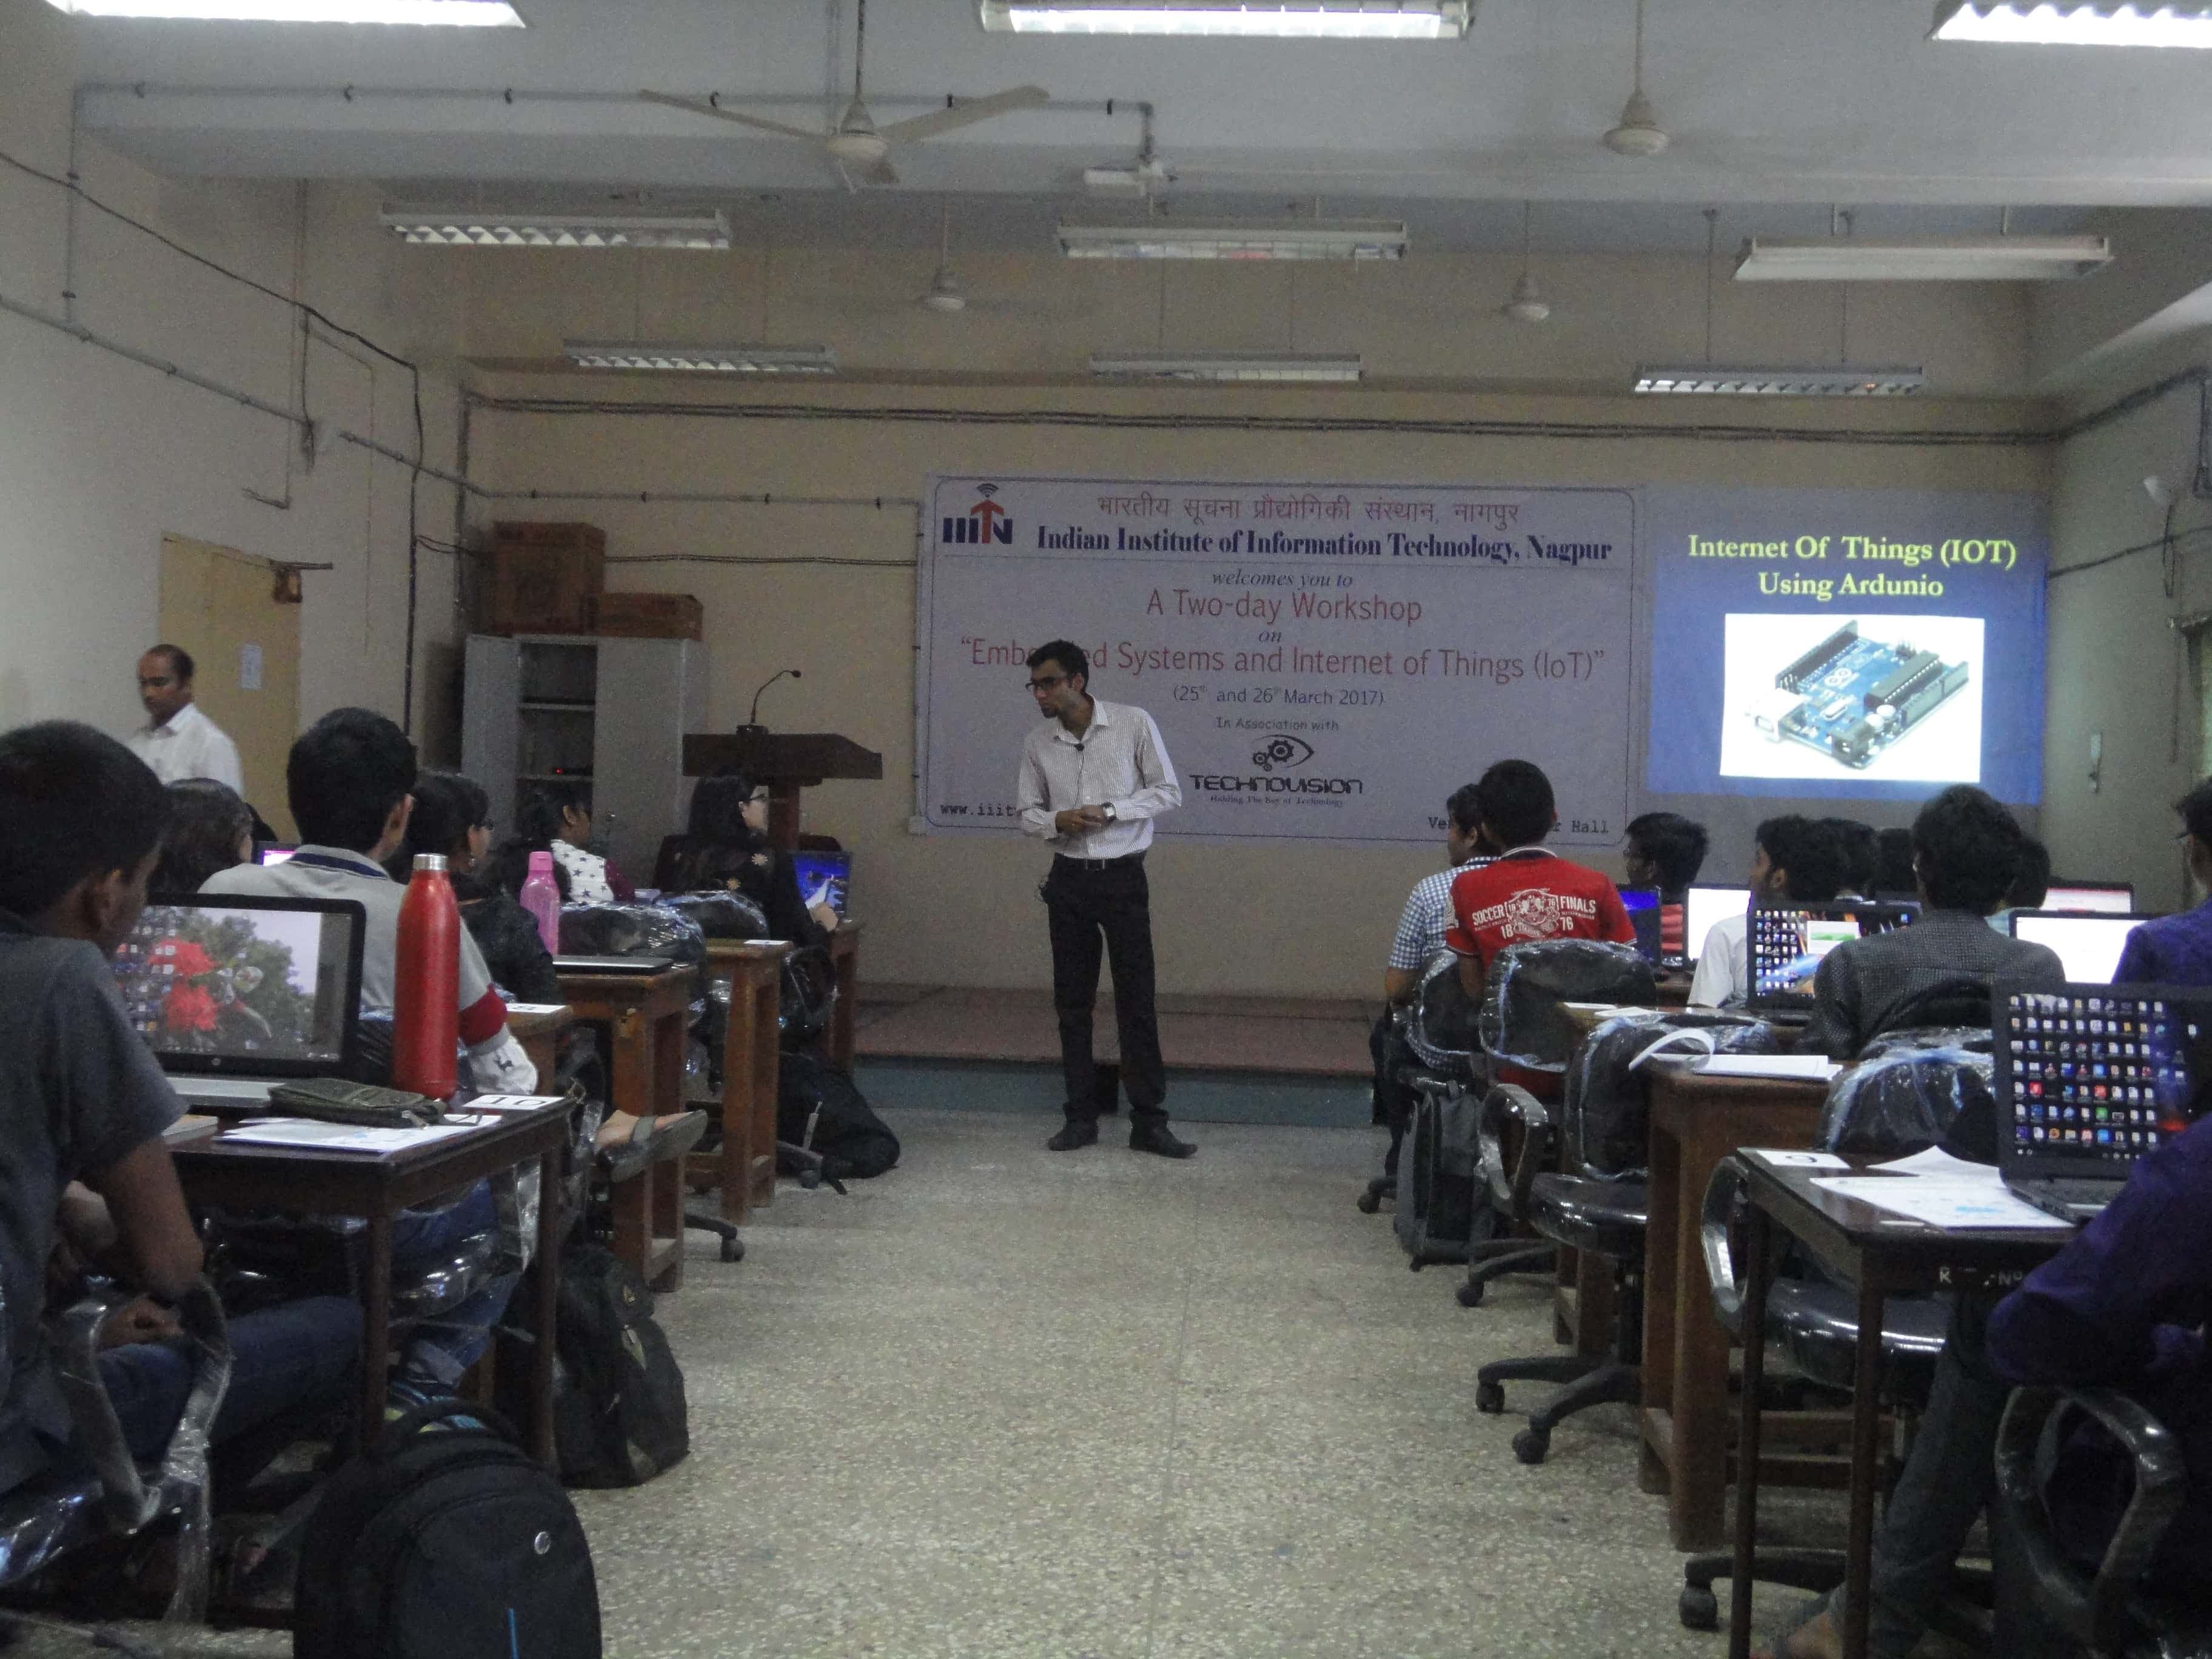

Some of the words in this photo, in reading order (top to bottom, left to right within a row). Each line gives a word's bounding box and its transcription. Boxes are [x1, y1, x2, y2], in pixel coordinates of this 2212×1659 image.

[1098, 491, 1169, 517] भारतीय
[1184, 499, 1241, 525] सूचना
[1453, 503, 1520, 531] नागपुर
[1037, 526, 1109, 550] Indian
[1118, 527, 1213, 553] Institute
[1219, 529, 1243, 553] of
[1247, 529, 1381, 557] Information
[1388, 532, 1520, 565] Technology,
[1526, 535, 1612, 565] Nagpur
[1689, 535, 1788, 558] Internet
[1795, 536, 1831, 559] Of
[1842, 536, 1932, 567] Things
[1940, 539, 2016, 571] (IOT)
[1213, 568, 1293, 586] welcomes
[1298, 575, 1330, 590] you
[1337, 573, 1353, 587] to
[1758, 572, 1833, 601] Using
[1838, 574, 1943, 597] Ardunio
[1146, 588, 1164, 615] A
[1173, 589, 1282, 625] Two-day
[1293, 592, 1422, 626] Workshop
[1258, 631, 1282, 643] on
[1118, 642, 1224, 677] Systems
[1235, 646, 1282, 673] and
[1293, 646, 1393, 676] Internet
[1404, 649, 1431, 676] of
[1438, 649, 1524, 685] Things
[1217, 688, 1247, 703] and
[1284, 689, 1333, 704] March
[1339, 689, 1384, 707] 2017)
[1216, 716, 1230, 728] In
[1235, 717, 1307, 730] Association
[1311, 719, 1339, 732] with
[1571, 820, 1609, 835] Hall
[1472, 903, 1506, 926] SOCCER
[1560, 896, 1597, 914] FINALS
[1500, 923, 1514, 939] 18
[1560, 916, 1574, 931] 76
